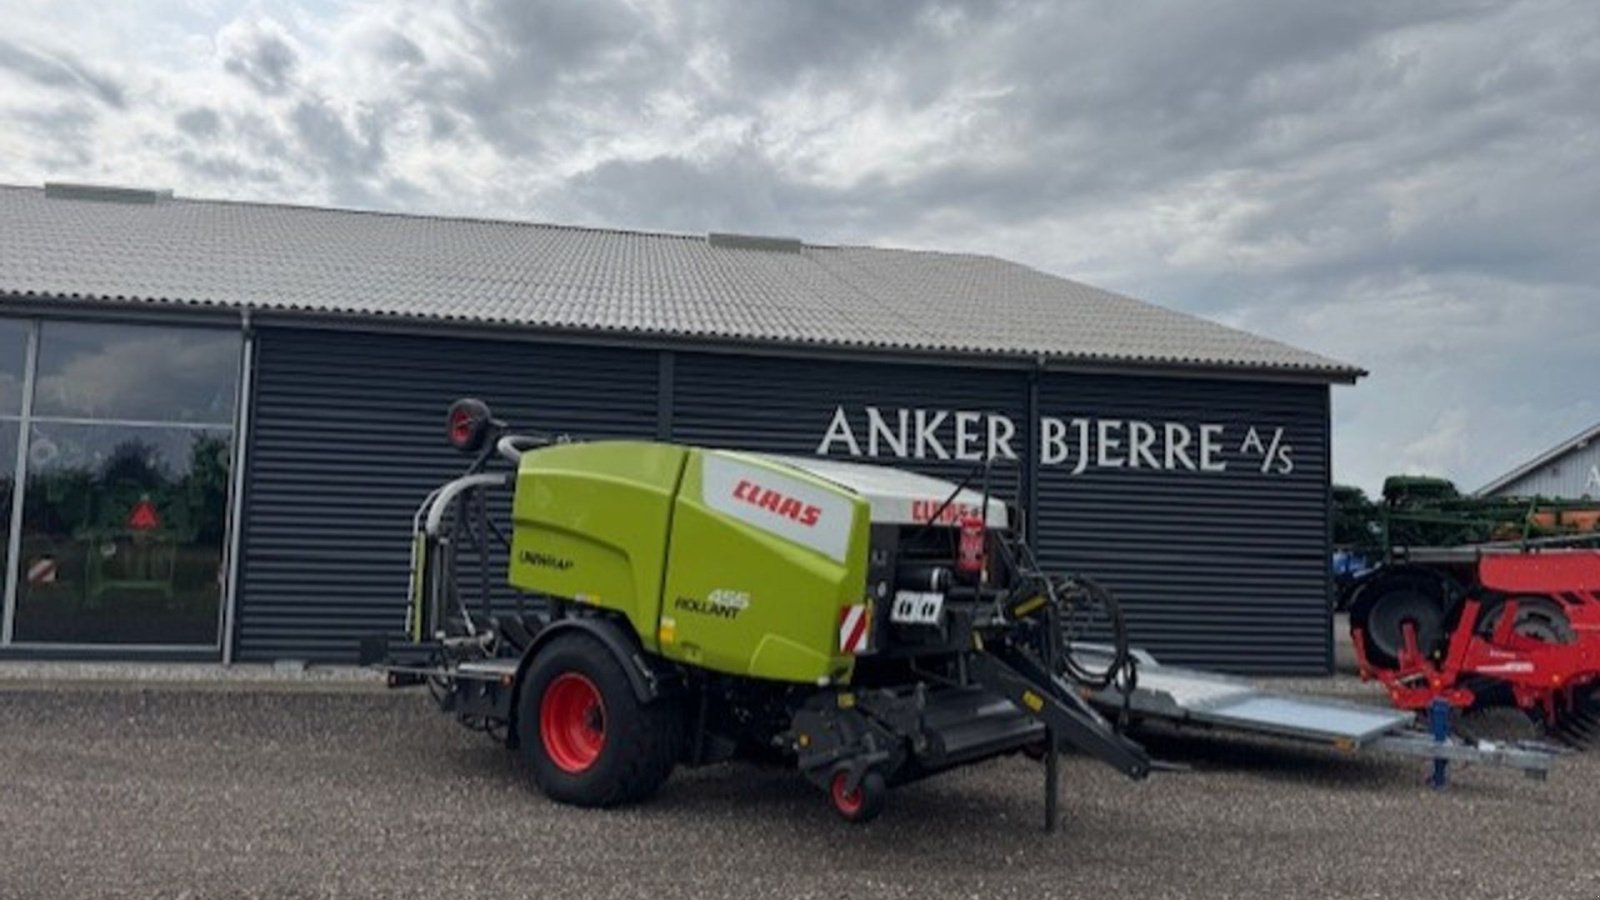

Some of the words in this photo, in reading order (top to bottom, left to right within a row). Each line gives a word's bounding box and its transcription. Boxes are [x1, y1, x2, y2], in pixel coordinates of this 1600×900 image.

[817, 406, 1018, 461] ANKER
[1040, 417, 1226, 475] BJERRE
[1240, 427, 1294, 474] A/S
[733, 480, 822, 527] CLAAS
